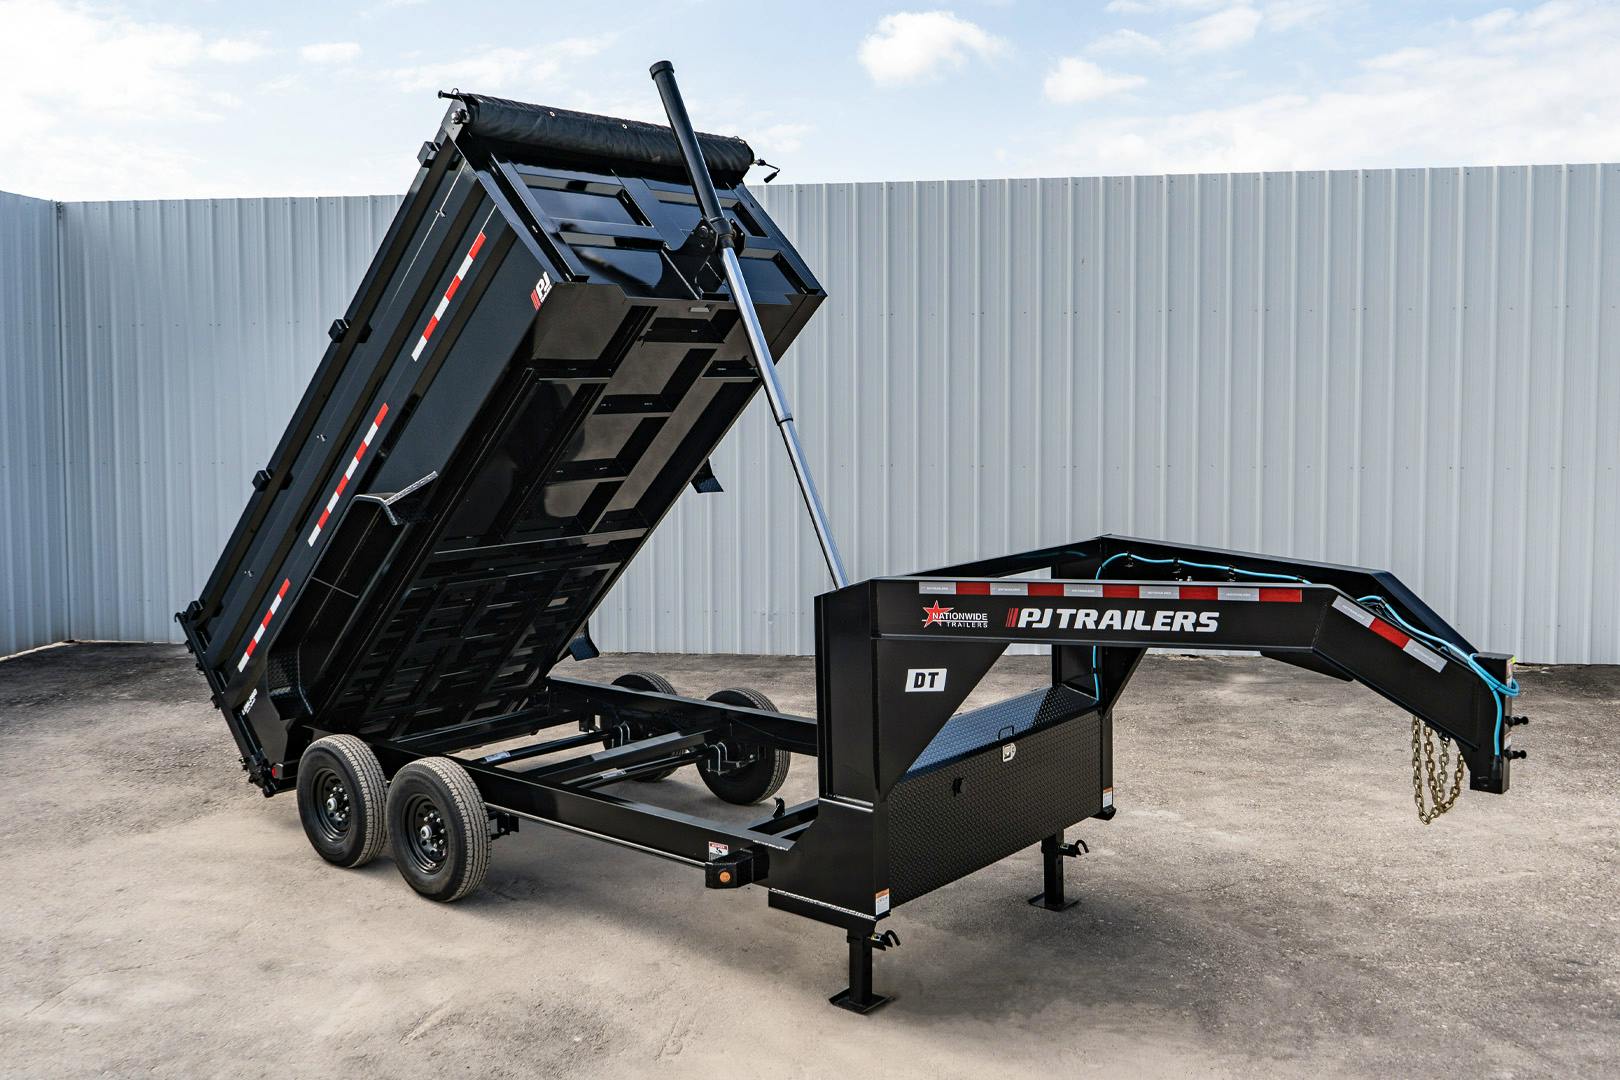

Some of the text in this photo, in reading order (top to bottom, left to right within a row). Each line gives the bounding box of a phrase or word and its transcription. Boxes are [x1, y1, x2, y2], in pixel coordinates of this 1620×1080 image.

[536, 271, 550, 300] PJ
[932, 612, 988, 621] NATIONWIDE
[1017, 608, 1220, 633] PJ TRAILERS
[913, 671, 940, 689] DT
